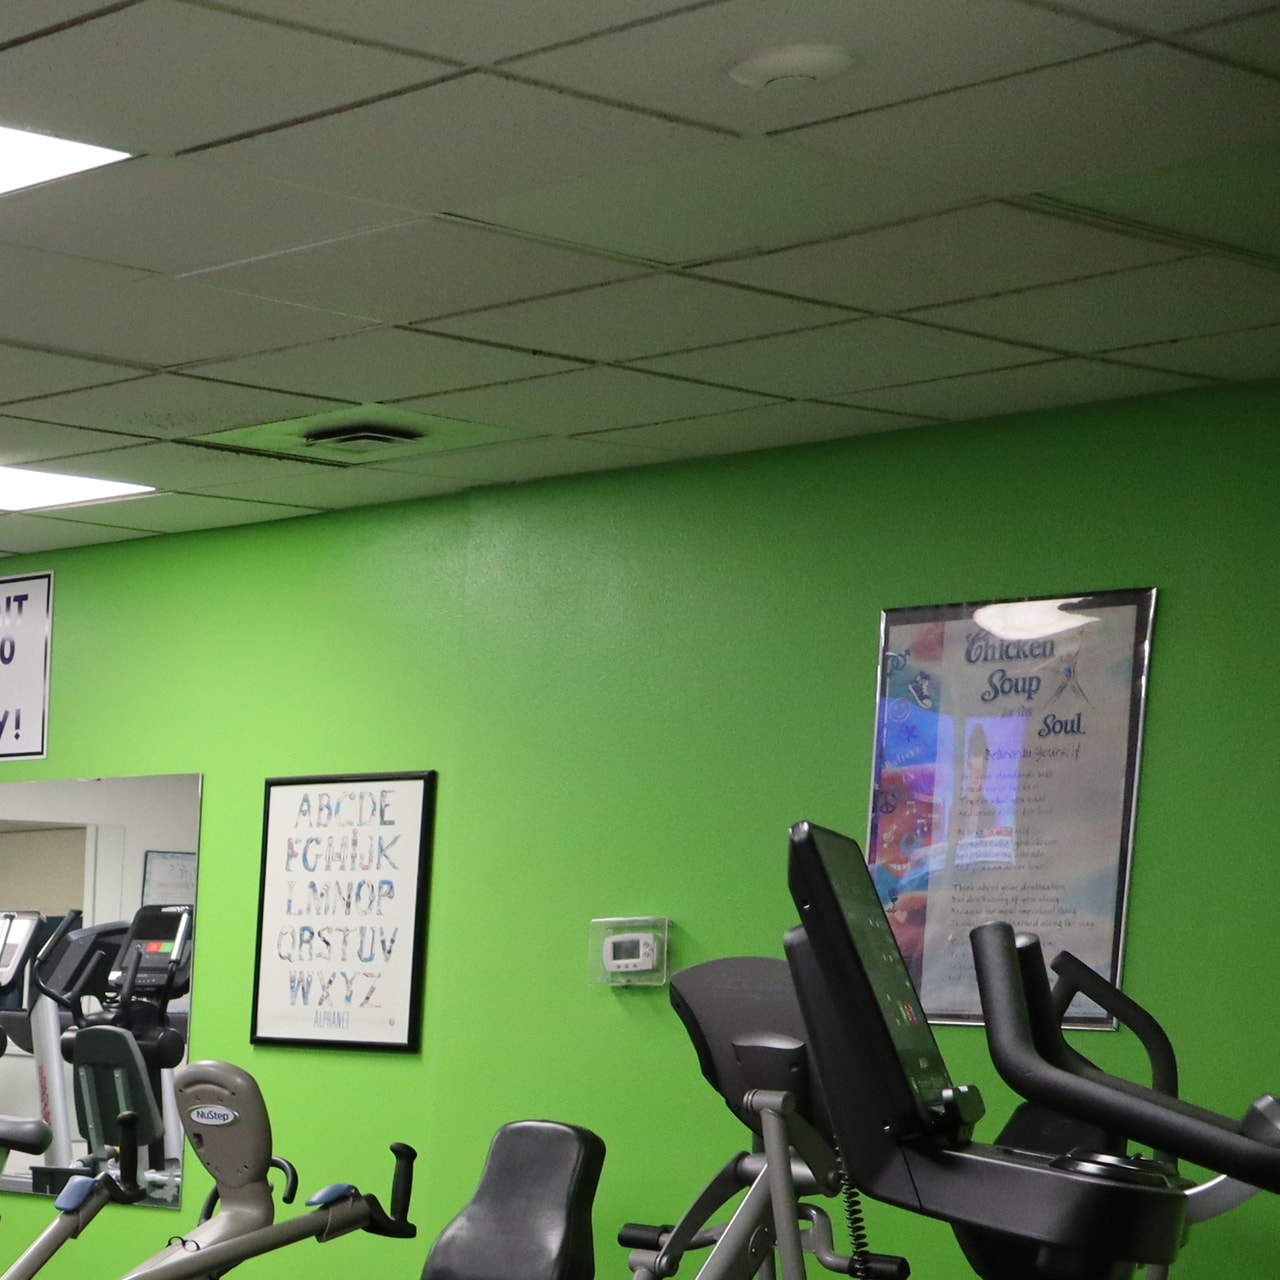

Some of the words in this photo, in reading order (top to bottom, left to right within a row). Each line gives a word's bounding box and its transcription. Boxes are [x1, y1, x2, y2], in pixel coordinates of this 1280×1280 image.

[965, 628, 1056, 664] Chicken
[980, 668, 1042, 702] Soup
[196, 1110, 230, 1122] NuStep
